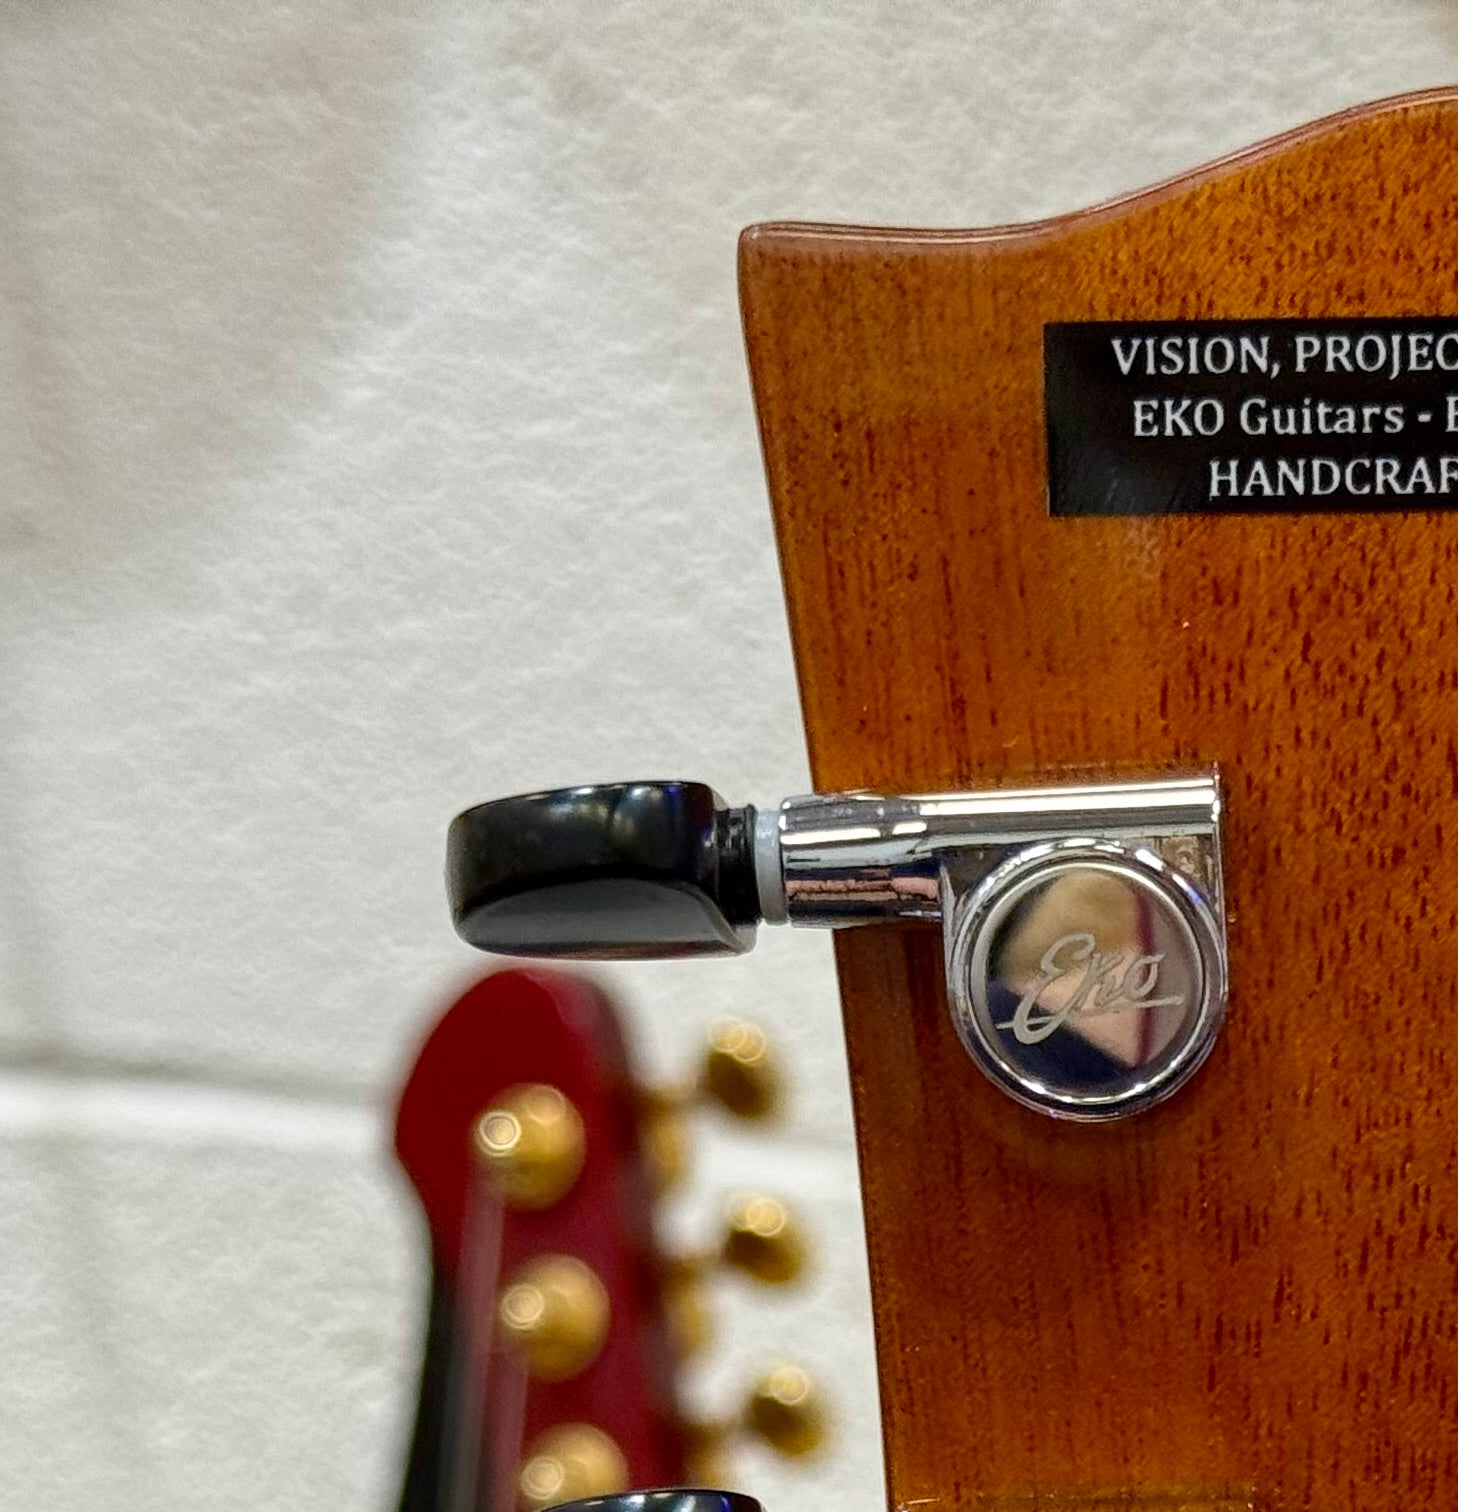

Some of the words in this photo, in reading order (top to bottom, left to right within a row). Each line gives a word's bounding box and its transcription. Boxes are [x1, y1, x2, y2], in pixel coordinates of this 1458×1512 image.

[1111, 335, 1280, 380] VISION,
[1133, 398, 1226, 437] EKO
[1239, 397, 1405, 435] Guitars
[1008, 930, 1170, 1045] Eko
